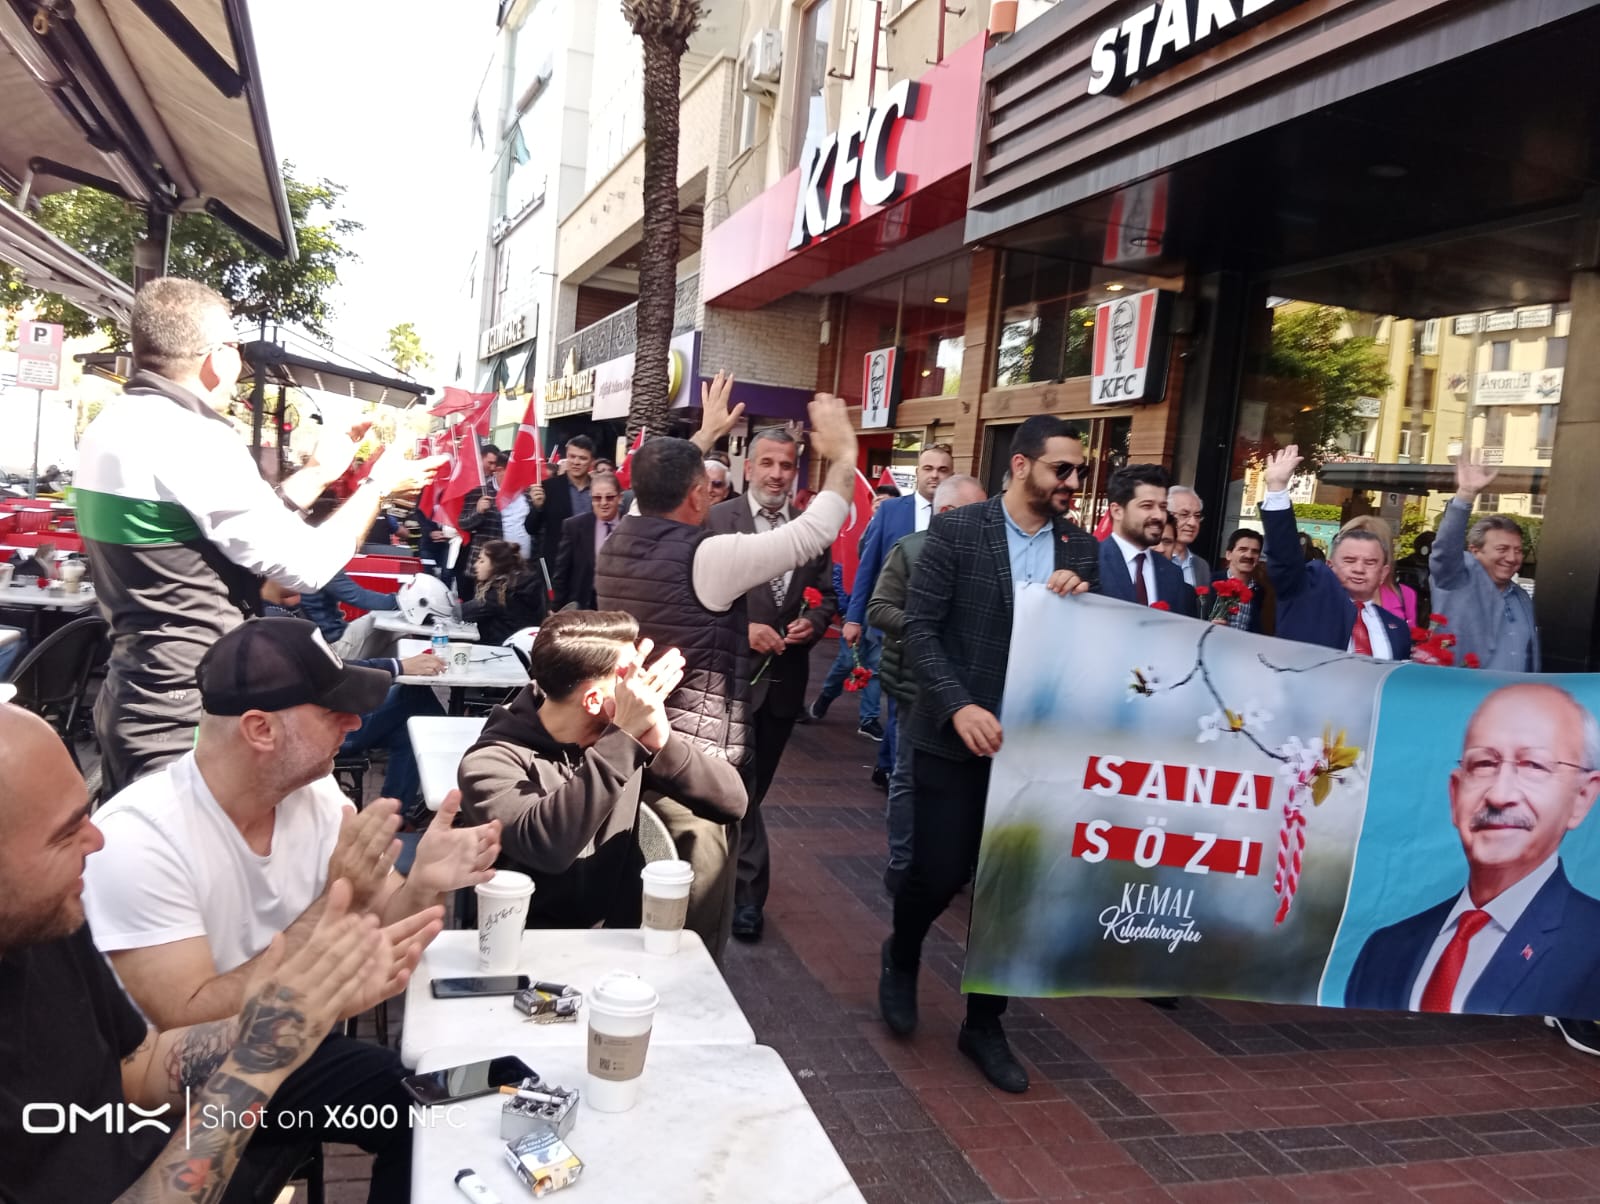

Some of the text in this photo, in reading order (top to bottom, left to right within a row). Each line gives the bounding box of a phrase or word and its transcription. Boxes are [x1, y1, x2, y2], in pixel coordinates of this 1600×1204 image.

[1087, 0, 1276, 96] STAR
[787, 79, 911, 252] KFC
[33, 326, 48, 342] P
[1098, 373, 1137, 400] KFC
[1090, 754, 1259, 814] SANA
[1081, 816, 1251, 879] SÖZ!
[1120, 882, 1195, 919] KEMAL
